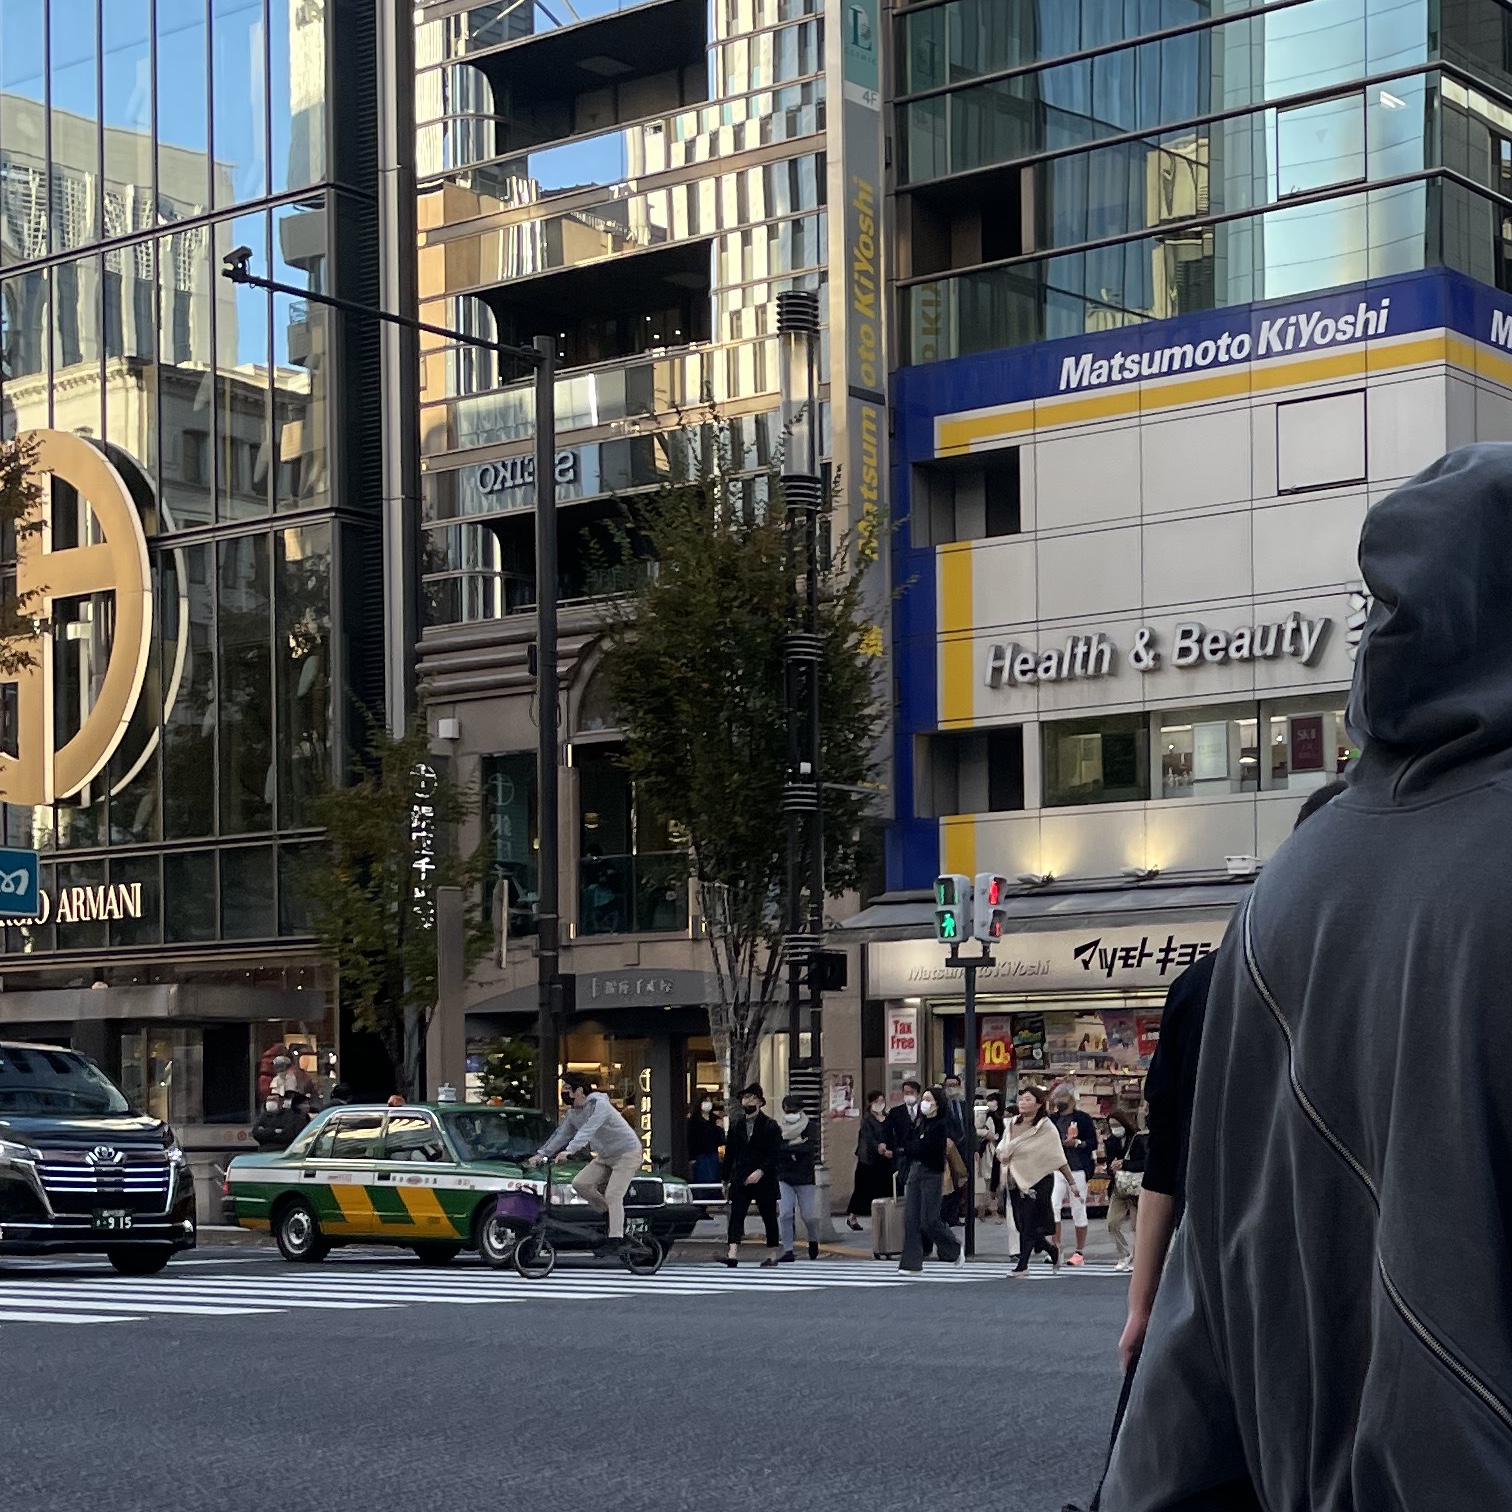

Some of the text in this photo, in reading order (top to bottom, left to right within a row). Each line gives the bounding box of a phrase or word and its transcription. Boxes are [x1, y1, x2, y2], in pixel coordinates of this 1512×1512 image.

[863, 90, 877, 104] 4F
[853, 176, 875, 318] KiYoshi
[1059, 298, 1390, 391] Matsumoto KiYoshi
[985, 611, 1332, 688] Health & Beauty
[56, 882, 142, 923] ARMANI
[907, 965, 993, 982] Matsumto
[893, 1019, 913, 1034] Tax
[891, 1036, 915, 1049] Free
